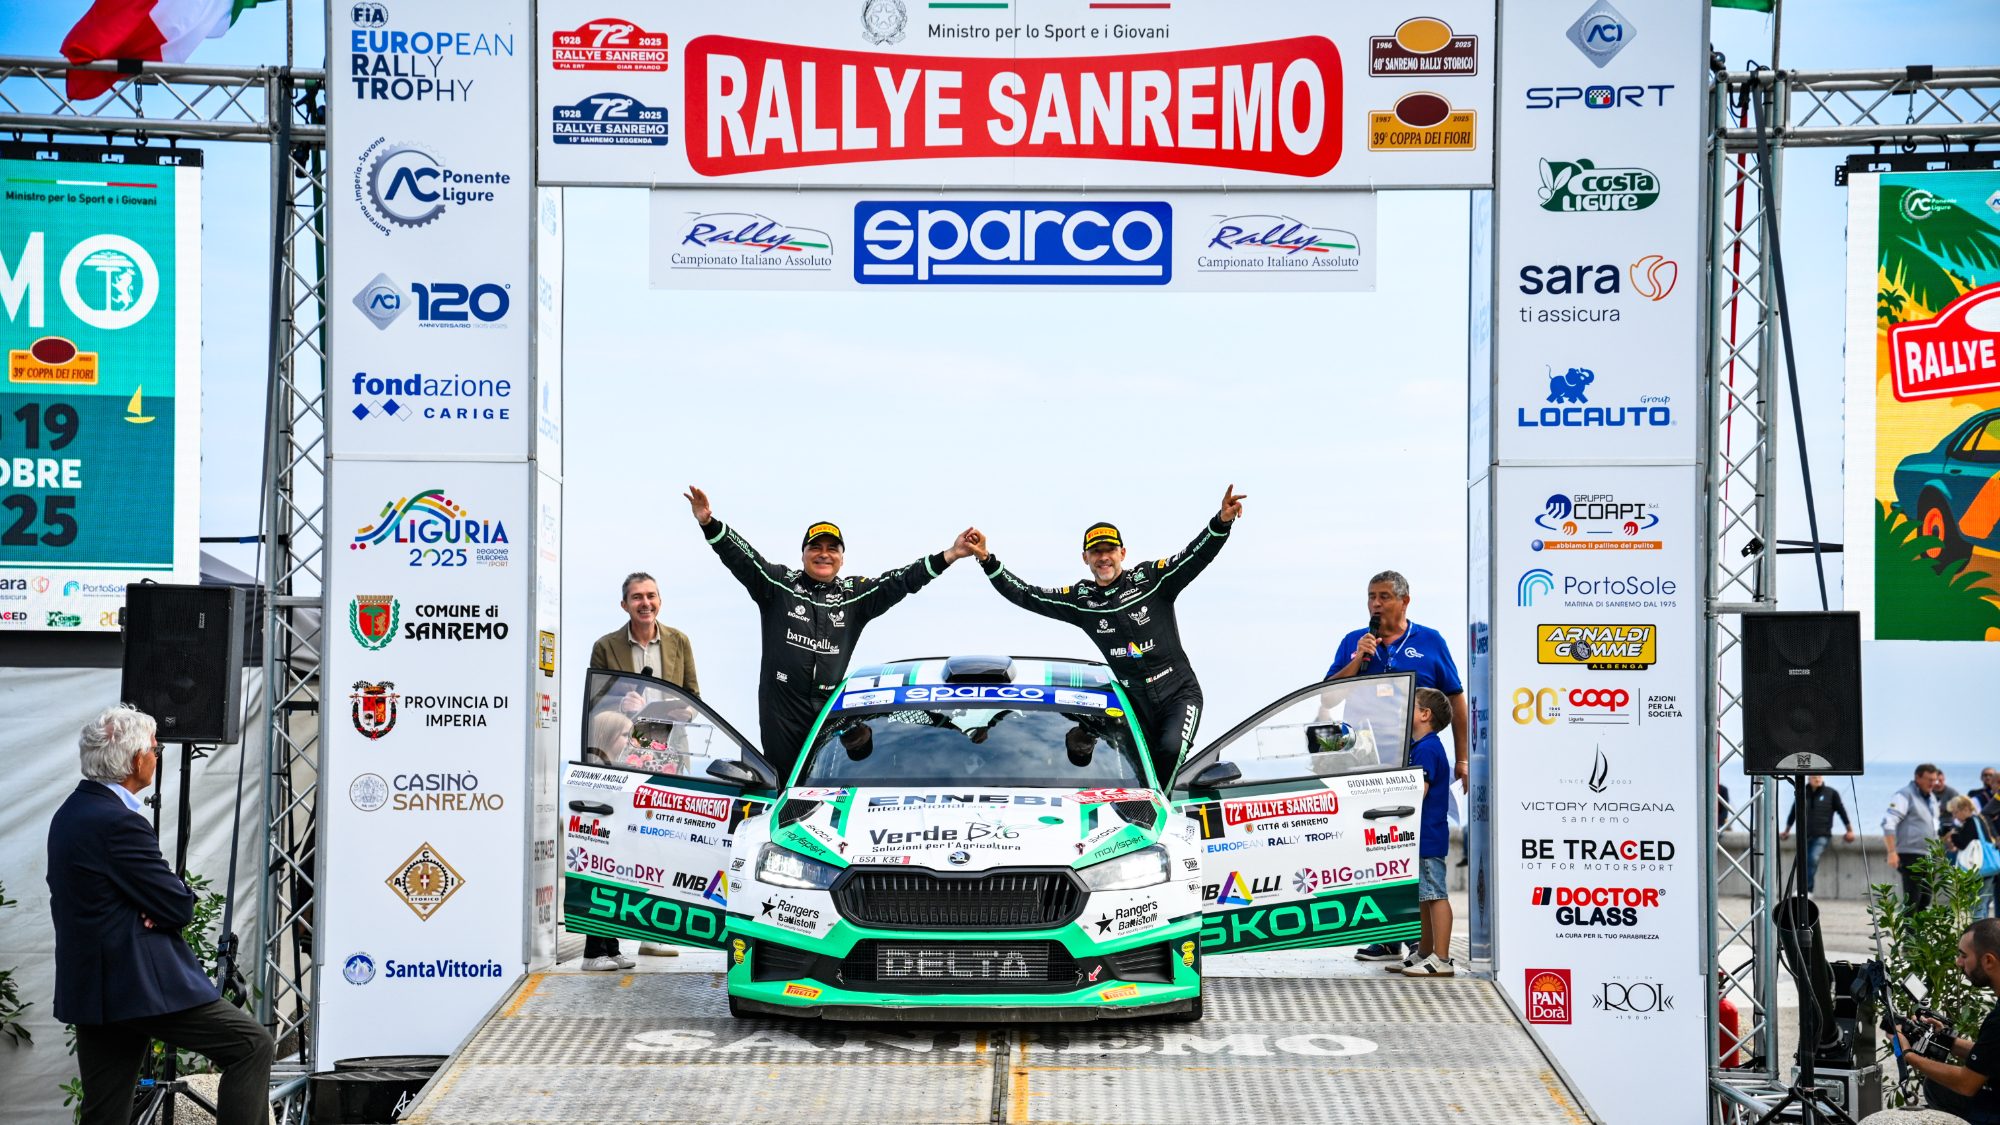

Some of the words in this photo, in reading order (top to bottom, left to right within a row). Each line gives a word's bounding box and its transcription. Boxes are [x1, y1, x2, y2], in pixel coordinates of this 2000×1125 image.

[559, 36, 581, 45] 1928
[638, 38, 662, 46] 2025
[928, 24, 995, 39] Ministro
[997, 27, 1022, 42] per
[1026, 24, 1040, 39] lo
[1044, 24, 1086, 41] Sport
[1090, 28, 1100, 39] e
[1104, 24, 1109, 39] i
[1113, 25, 1170, 40] Giovani
[1587, 24, 1623, 43] ACI
[351, 29, 514, 57] EUROPEAN
[555, 50, 601, 60] RALLYE
[605, 51, 665, 61] SANREMO
[1385, 58, 1418, 70] SANREMO
[1420, 57, 1441, 70] RALLY
[1443, 56, 1473, 70] STORICO
[351, 53, 444, 78] RALLY
[351, 77, 474, 102] TROPHY
[1526, 84, 1675, 109] SPORT
[559, 110, 581, 118] 1928
[638, 111, 662, 119] 2025
[706, 53, 963, 159] RALLYE
[986, 57, 1326, 156] SANREMO
[555, 124, 601, 133] RALLYE
[605, 125, 665, 134] SANREMO
[1390, 132, 1421, 145] COPPA
[1424, 131, 1441, 144] DEI
[1443, 131, 1471, 144] FIORI
[354, 170, 363, 202] Imperia
[443, 169, 511, 185] Ponente
[6, 191, 46, 202] Ministro
[48, 193, 64, 204] per
[67, 194, 76, 204] lo
[79, 195, 105, 204] Sport
[122, 196, 157, 206] Giovani
[443, 187, 495, 206] Ligure
[682, 222, 796, 253] Rally
[864, 209, 1164, 281] sparco
[1208, 223, 1322, 255] Rally
[671, 253, 738, 267] Campionato
[740, 254, 782, 266] Italiano
[784, 254, 832, 266] Assoluto
[1197, 255, 1264, 271] Campionato
[1267, 255, 1309, 267] Italiano
[1311, 256, 1359, 267] Assoluto
[1519, 264, 1620, 295] sara
[1519, 307, 1532, 322] ti
[1538, 306, 1621, 322] assicura
[1904, 338, 1997, 385] RALLYE
[27, 367, 54, 378] COPPA
[56, 368, 70, 379] DEI
[72, 369, 94, 379] FIORI
[352, 372, 511, 397] fondazione
[1640, 395, 1671, 405] Group
[423, 407, 511, 420] CARIGE
[1518, 406, 1670, 427] LOCAUTO
[13, 401, 80, 451] 19
[1574, 494, 1614, 503] GRUPPO
[1573, 503, 1646, 520] COAPI
[395, 518, 510, 544] LIGURIA
[409, 548, 468, 567] 2025
[1564, 576, 1677, 595] PortoSole
[415, 604, 481, 618] COMUNE
[485, 604, 499, 618] di
[404, 622, 509, 642] SANREMO
[1546, 626, 1650, 643] ARNALDI
[404, 695, 490, 710] PROVINCIA
[493, 695, 509, 709] DI
[904, 684, 1045, 702] sparco
[1568, 688, 1630, 712] coop
[425, 714, 488, 728] IMPERIA
[1648, 709, 1683, 718] SOCIETÀ
[393, 770, 479, 791] CASINÒ
[392, 793, 504, 811] SANREMO
[650, 790, 685, 810] RALLYE
[684, 798, 729, 820] SANREMO
[868, 794, 1063, 807] ENNEBI
[1245, 800, 1284, 818] RALLYE
[1286, 794, 1336, 815] SANREMO
[1521, 801, 1588, 811] VICTORY
[1593, 802, 1675, 812] MORGANA
[1199, 804, 1211, 839] 1
[1561, 816, 1630, 824] sanremo
[640, 825, 688, 841] EUROPEAN
[690, 833, 719, 847] RALLY
[868, 824, 957, 846] Verde
[964, 821, 1020, 842] Bio
[1207, 838, 1264, 854] EUROPEAN
[1267, 835, 1301, 847] RALLY
[1304, 830, 1345, 843] TROPHY
[871, 844, 923, 853] Soluzioni
[925, 843, 946, 851] per
[1521, 838, 1555, 860] BE
[1563, 839, 1676, 861] TRACED
[590, 855, 665, 884] BIGonDRY
[1321, 858, 1411, 885] BIGonDRY
[1521, 862, 1543, 870] IOT
[1551, 863, 1576, 871] FOR
[1584, 863, 1674, 872] MOTORSPORT
[1556, 886, 1660, 908] DOCTOR
[777, 899, 820, 919] Rangers
[1115, 899, 1159, 920] Rangers
[1555, 906, 1638, 927] GLASS
[384, 959, 504, 978] SantaVittoria
[885, 950, 1030, 978] DELTA
[785, 985, 821, 999] PIRELLI
[1101, 986, 1139, 1000] PIRELLI
[1532, 991, 1565, 1006] PAN
[1601, 982, 1665, 1012] ROI
[1532, 1006, 1566, 1019] Dorà
